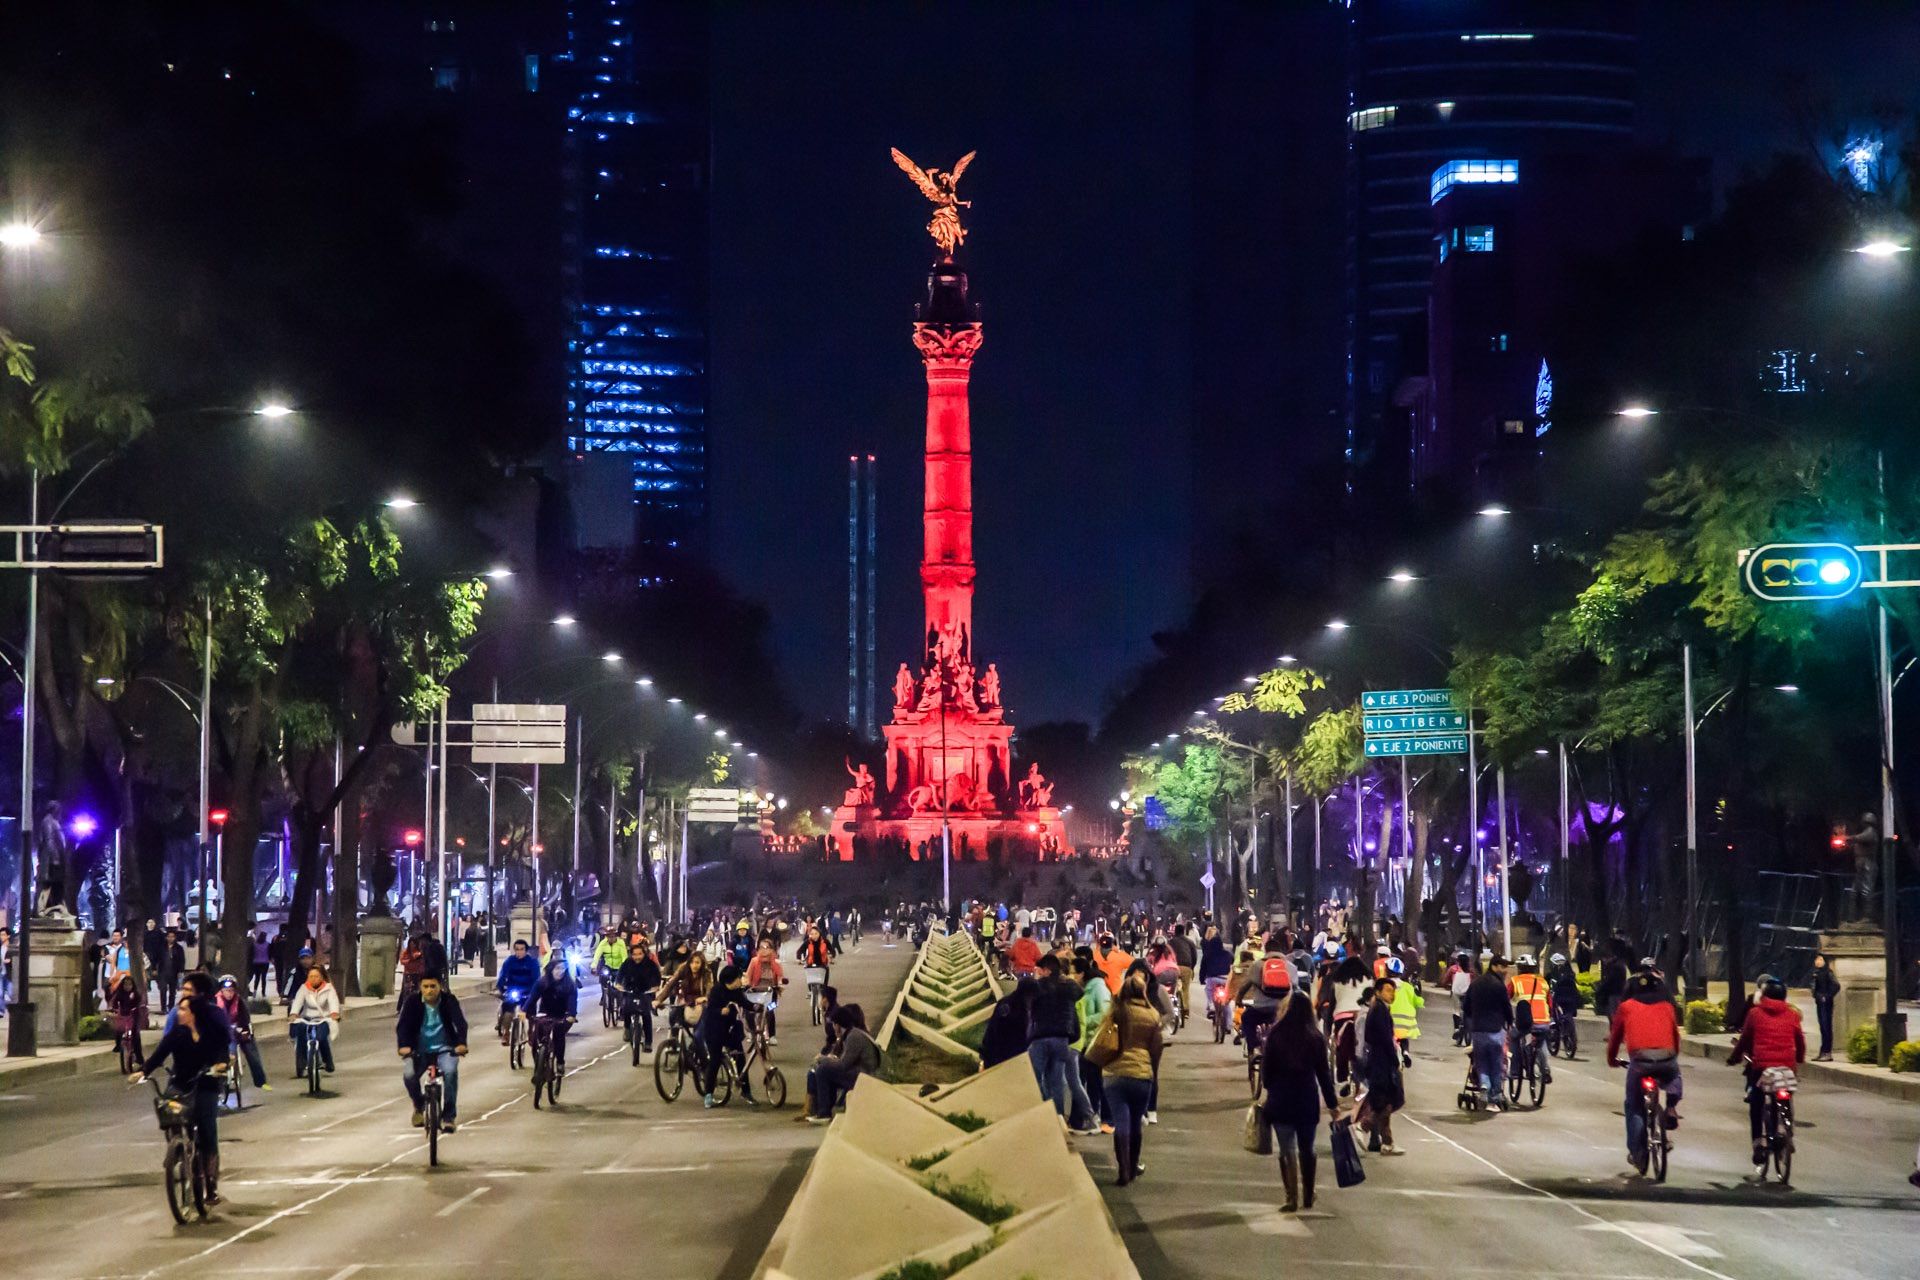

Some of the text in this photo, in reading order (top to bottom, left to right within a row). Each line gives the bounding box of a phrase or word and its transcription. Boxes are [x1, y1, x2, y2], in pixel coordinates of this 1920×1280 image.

[1380, 693, 1451, 705] EJE 3 PONIEN
[1366, 717, 1447, 729] RIO TIBER
[1383, 740, 1464, 752] EJE 2 PONIENTE
